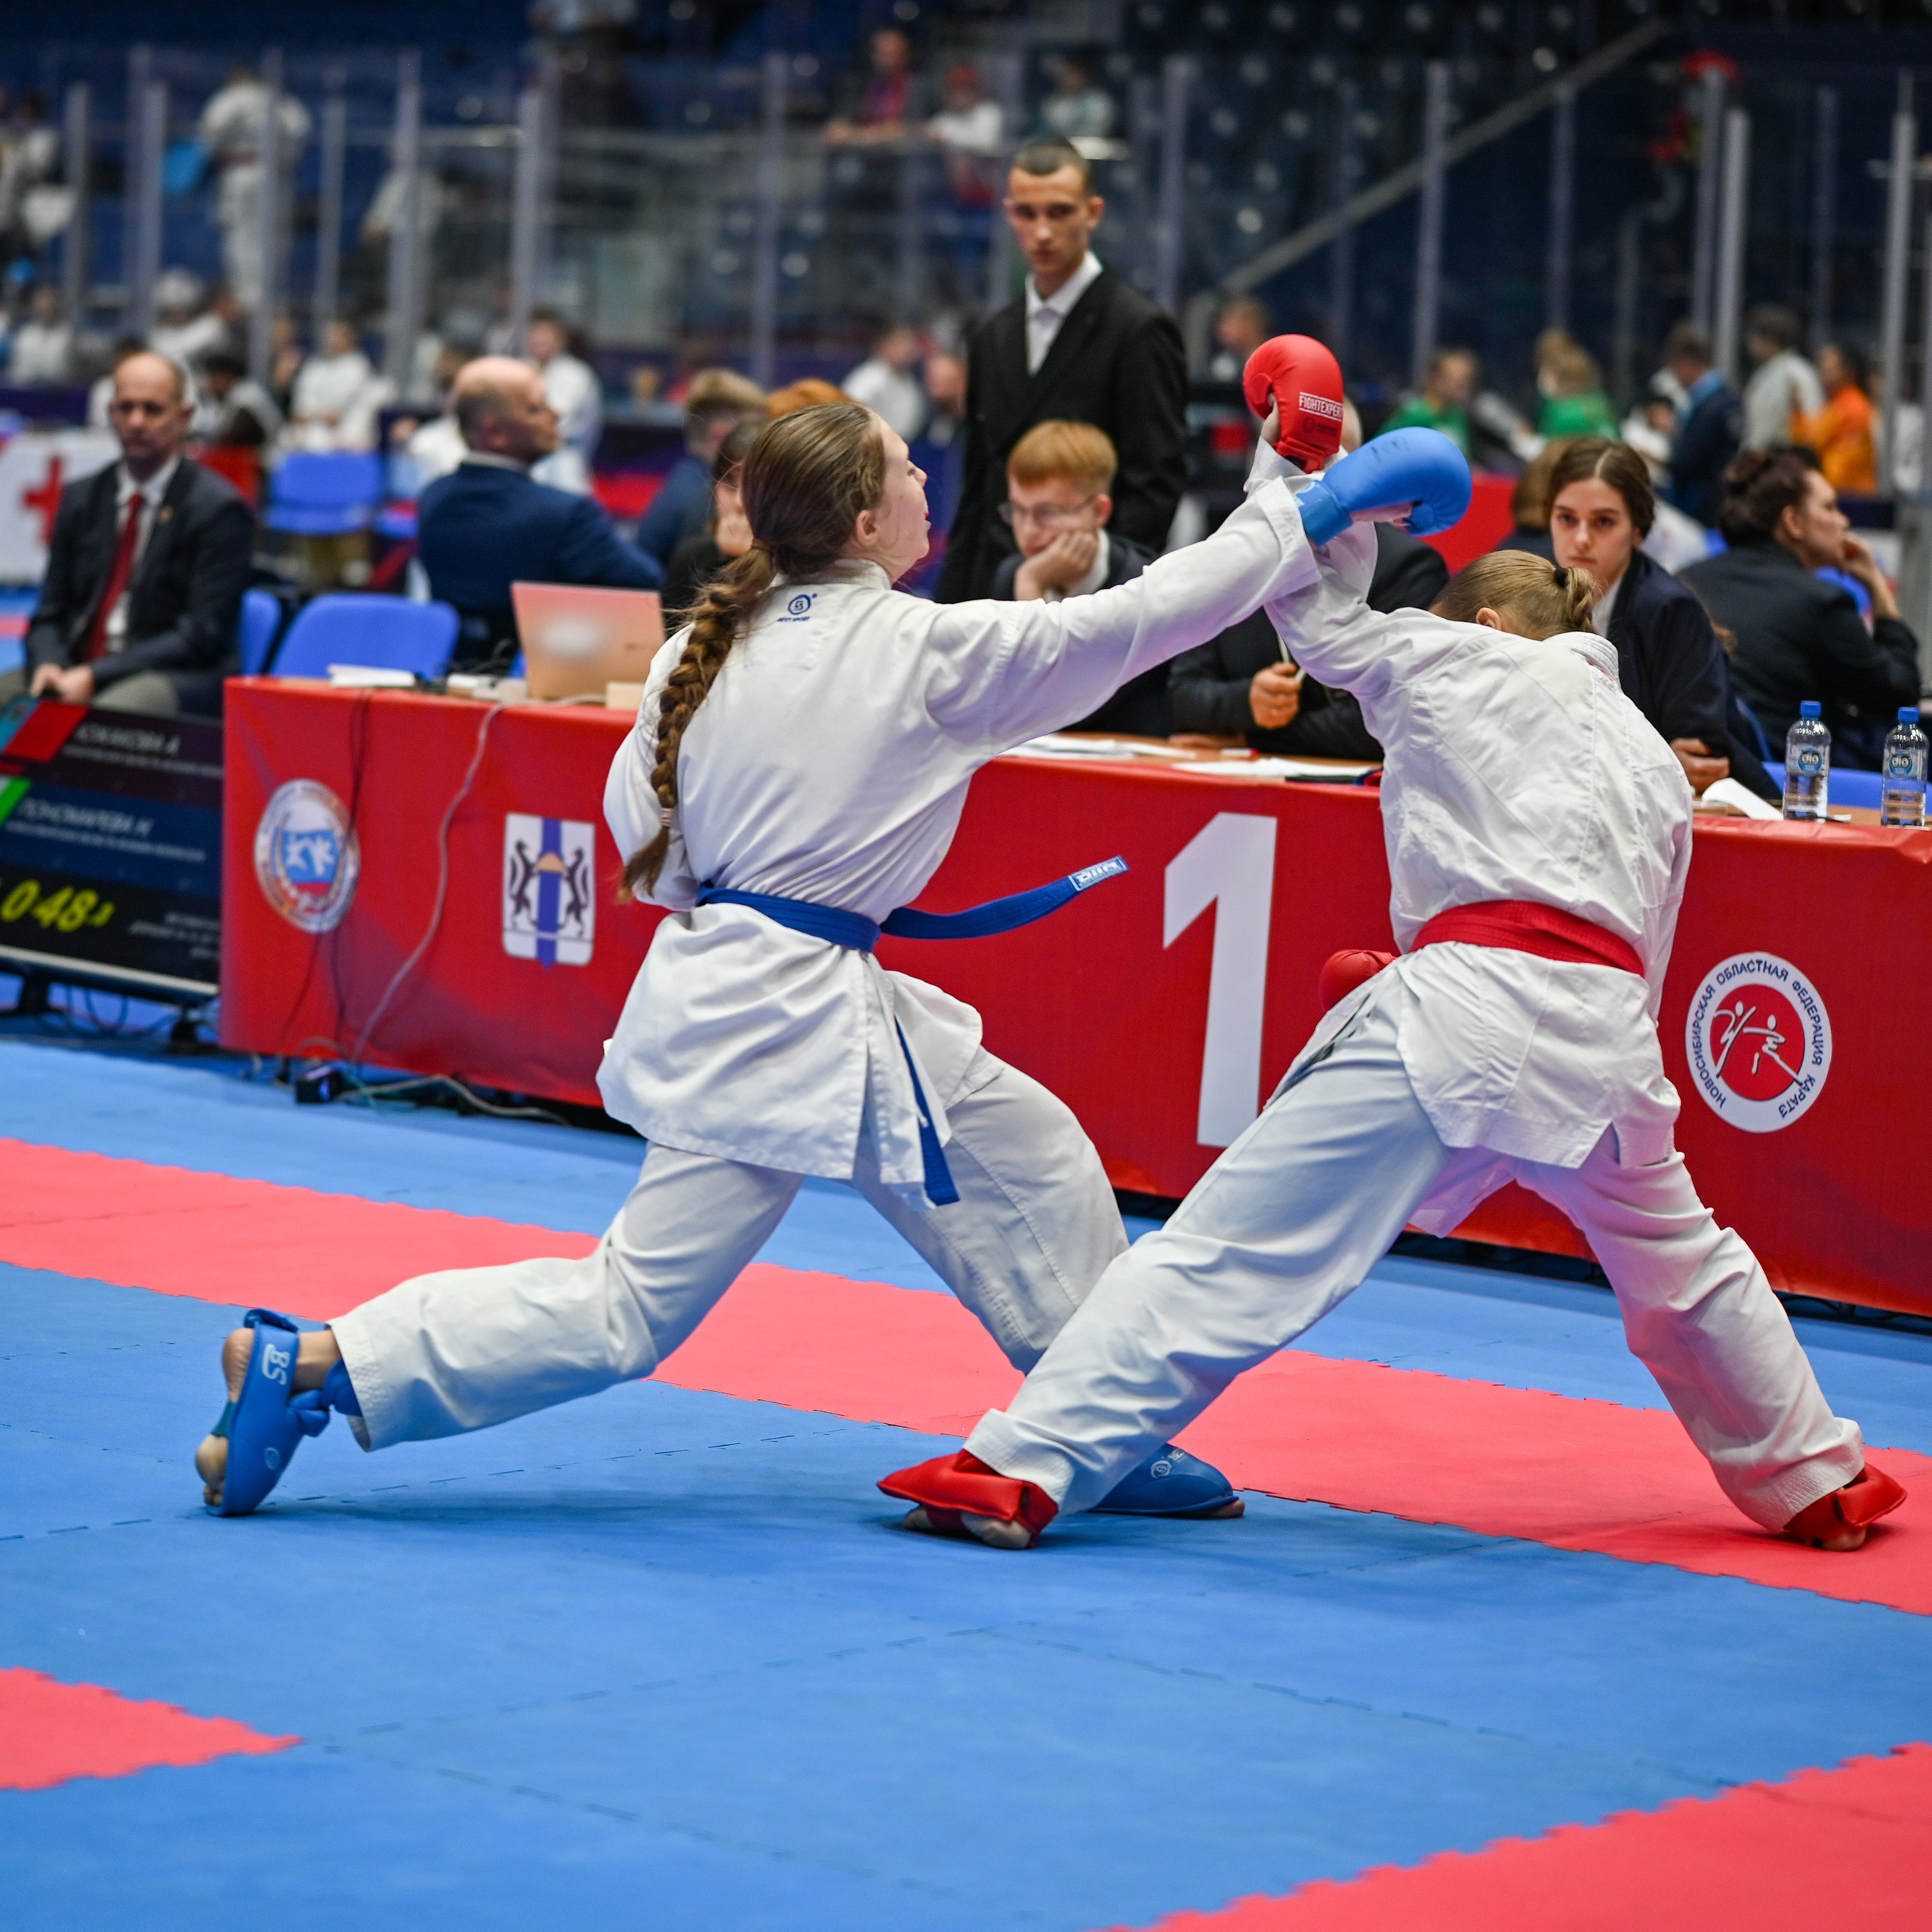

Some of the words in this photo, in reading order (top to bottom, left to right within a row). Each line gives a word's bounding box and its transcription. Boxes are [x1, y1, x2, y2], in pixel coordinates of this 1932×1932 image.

[1164, 812, 1278, 1146] 1
[1716, 958, 1789, 986] ОБЛАСТНАЯ
[1691, 983, 1727, 1109] НОВОСИБИРСКАЯ
[1792, 980, 1825, 1067] ФЕДЕРАЦИЯ
[1778, 1073, 1816, 1119] КАРАТЭ
[263, 1343, 291, 1385] BS
